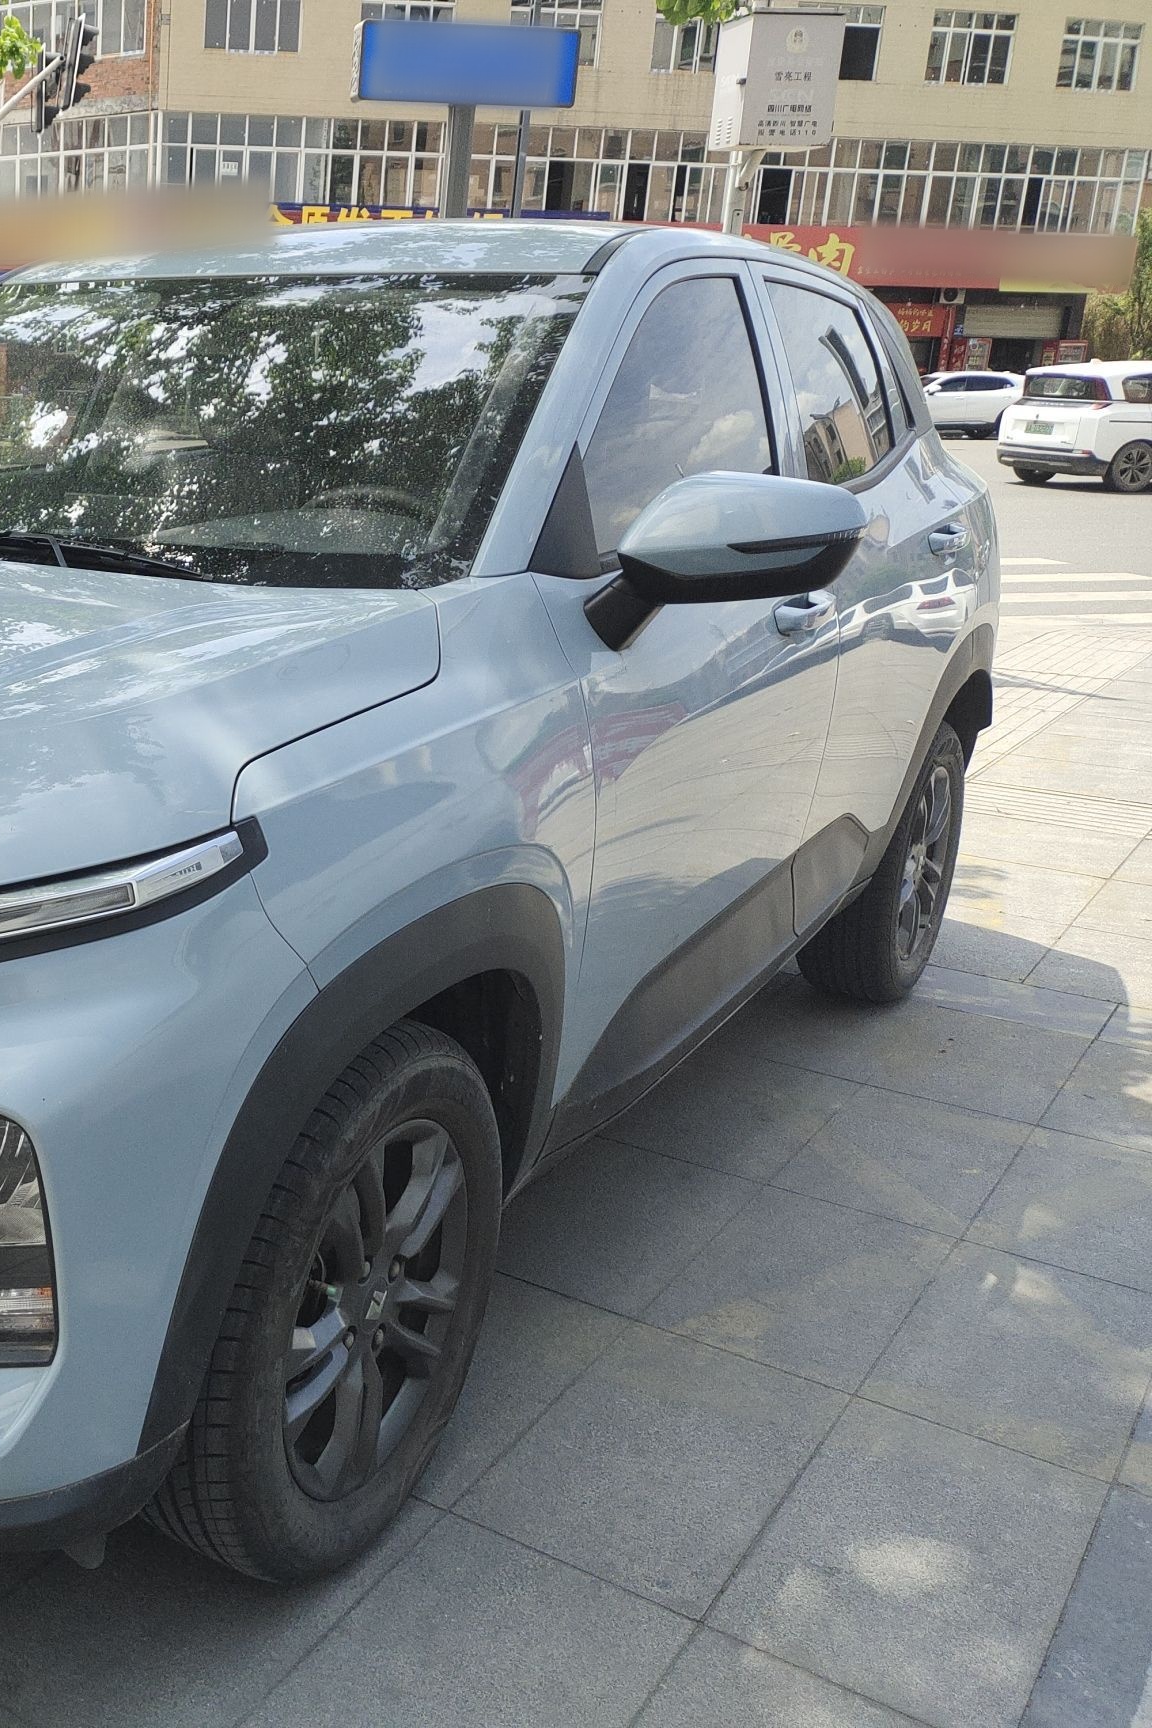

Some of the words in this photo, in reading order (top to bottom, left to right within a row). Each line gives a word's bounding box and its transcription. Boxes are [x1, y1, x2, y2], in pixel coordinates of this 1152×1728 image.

[774, 71, 813, 81] 雪亮工程
[767, 104, 813, 113] 四川广电网络
